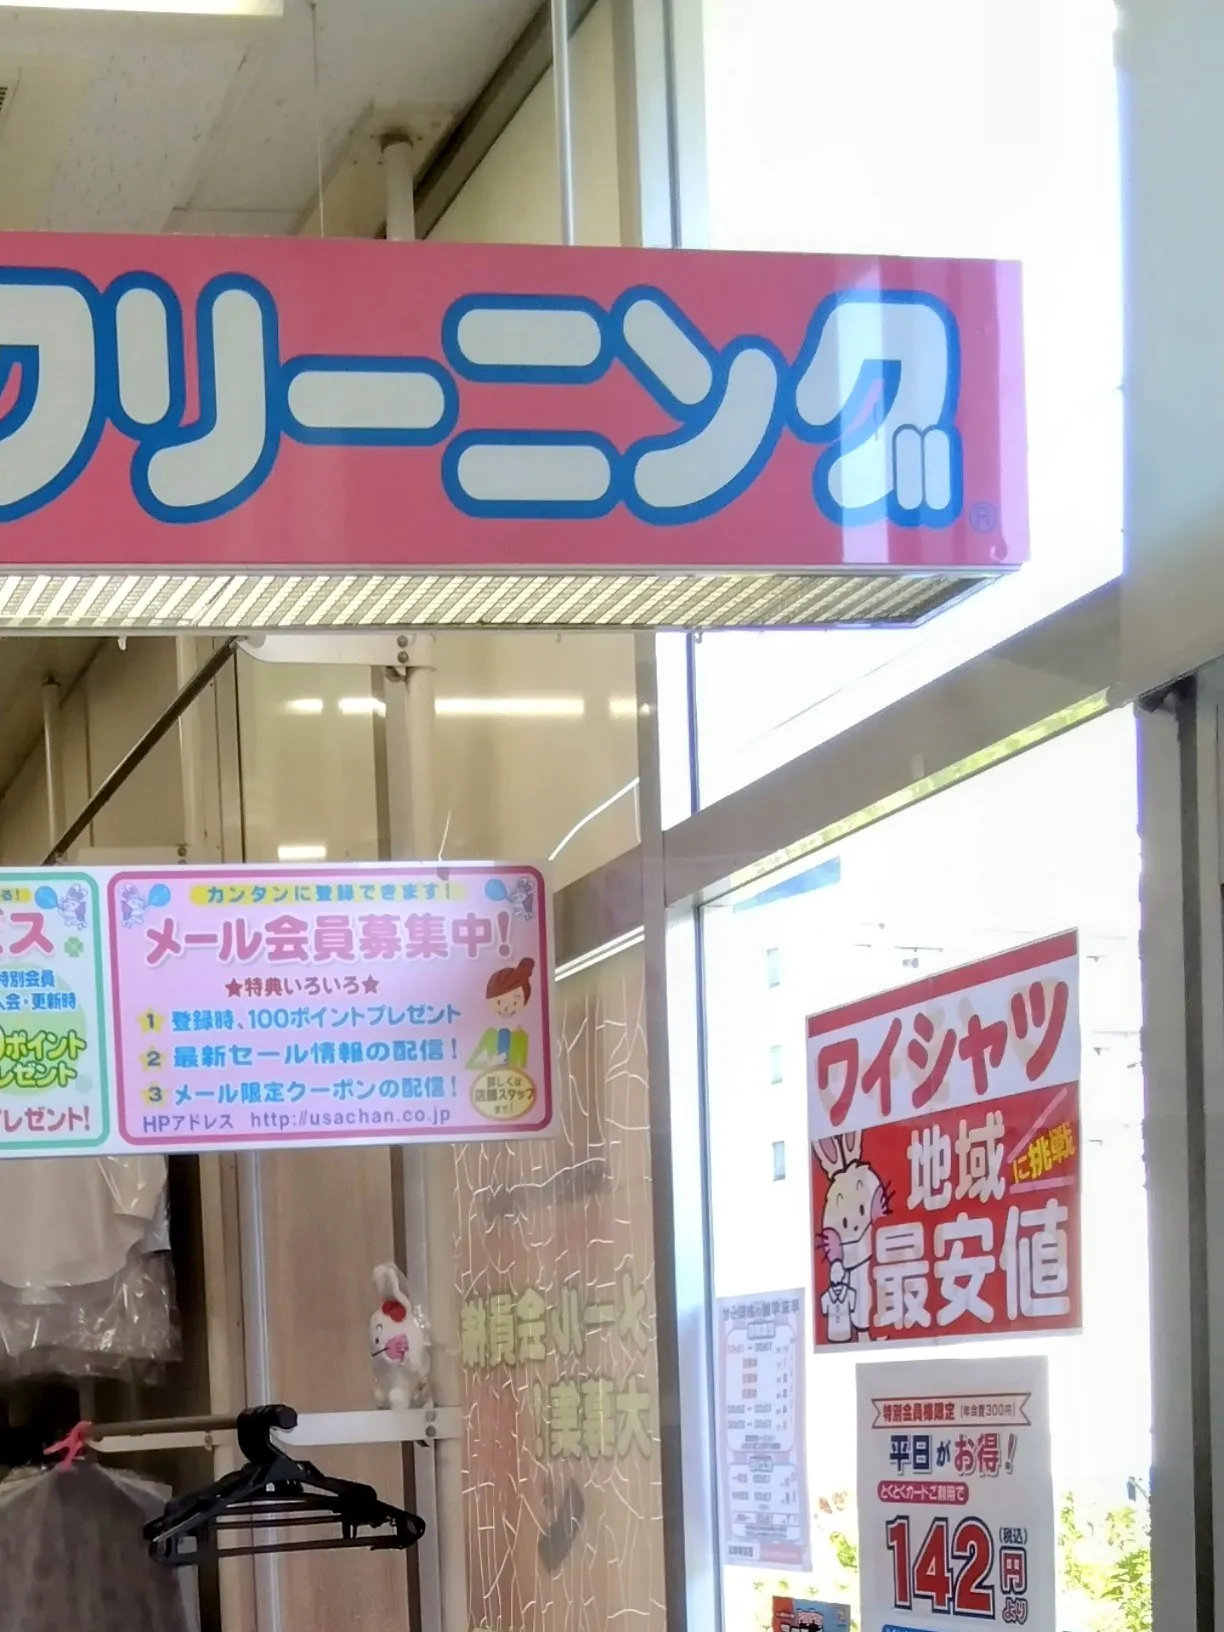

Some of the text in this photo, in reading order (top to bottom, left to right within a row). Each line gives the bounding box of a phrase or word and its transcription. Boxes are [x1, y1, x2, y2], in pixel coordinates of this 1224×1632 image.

[171, 1005, 462, 1034] 登録時、100ポイントプレゼント
[817, 979, 1070, 1128] ワイシャツ
[142, 1108, 452, 1134] HPアドレス http://usachan.co.jp
[1012, 1121, 1077, 1185] に挑戦
[906, 1109, 1007, 1212] 地域
[873, 1197, 1071, 1331] 最安値
[885, 1515, 997, 1620] 142
[999, 1546, 1028, 1595] 円
[1001, 1597, 1029, 1625] より
